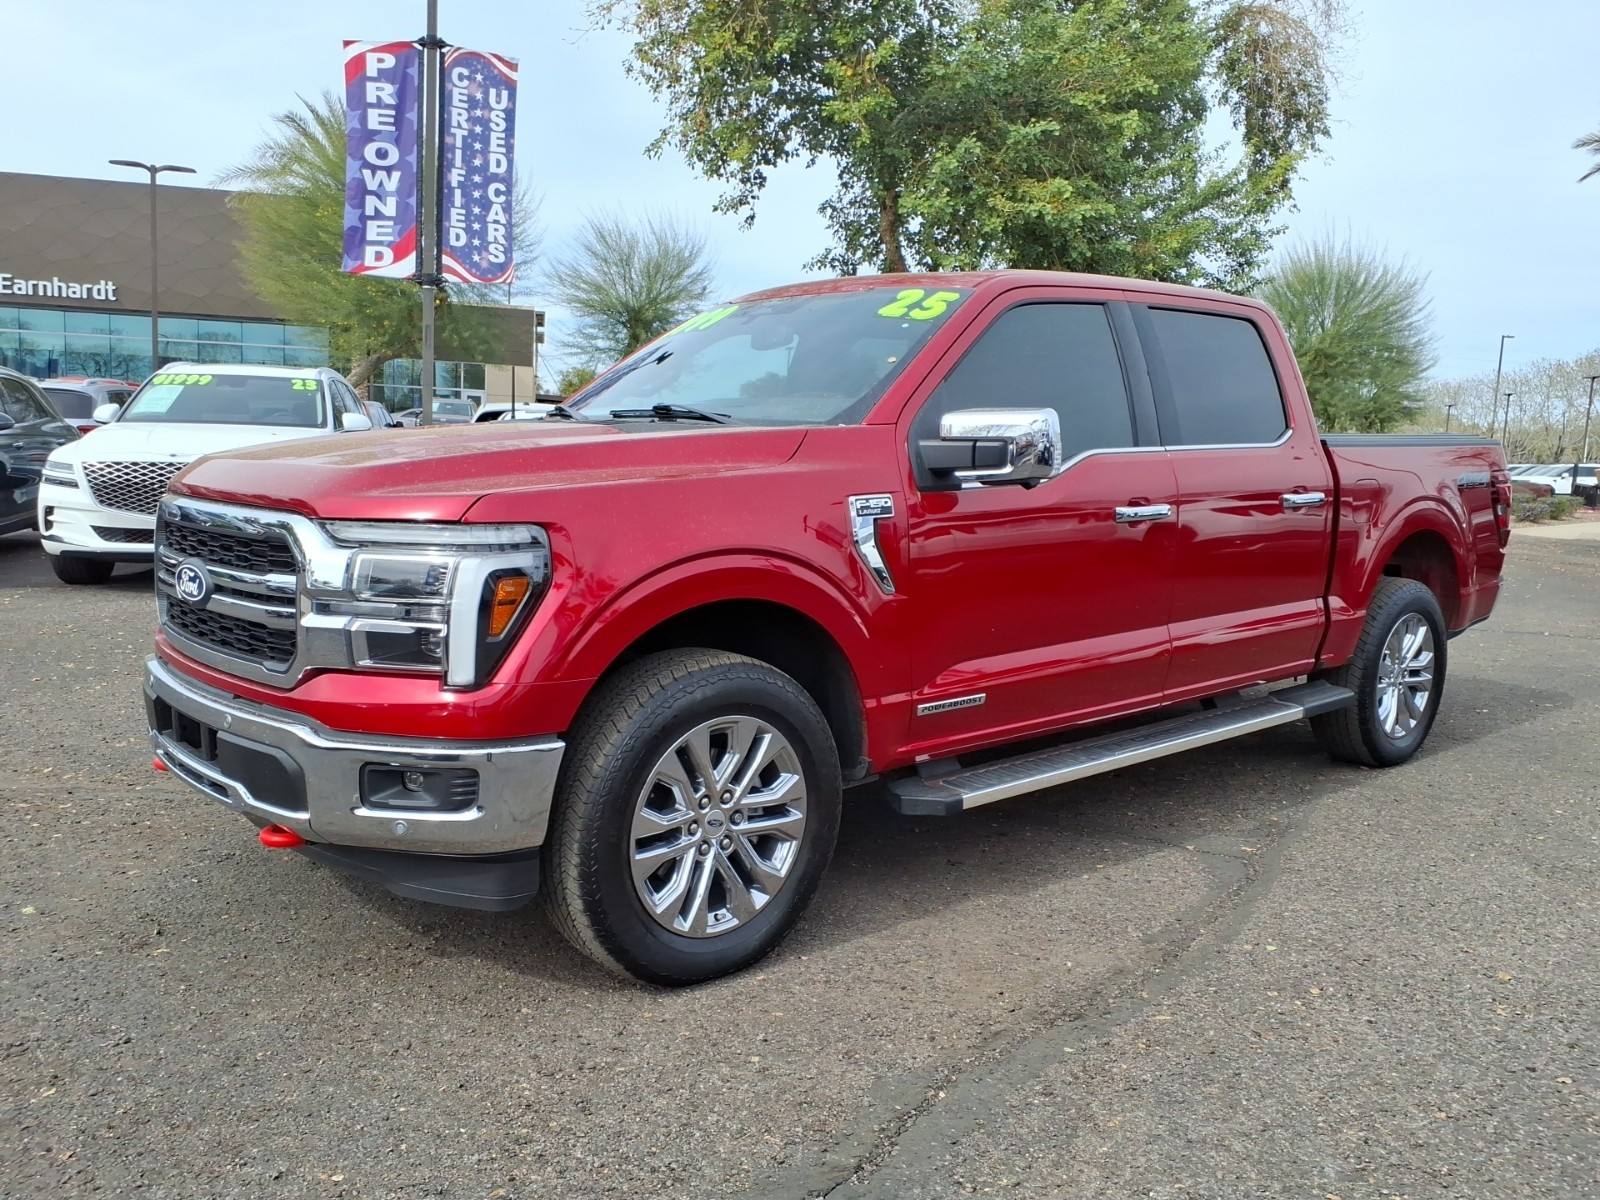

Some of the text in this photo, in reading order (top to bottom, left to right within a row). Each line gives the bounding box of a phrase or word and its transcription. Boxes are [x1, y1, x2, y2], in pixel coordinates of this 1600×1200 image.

[449, 66, 470, 247] CERTIFIED
[486, 87, 509, 263] USED CARS
[0, 273, 117, 301] Earnhardt
[877, 288, 961, 320] 25
[291, 379, 318, 391] 23
[180, 568, 200, 596] Ford
[921, 696, 983, 713] POWERBOOST
